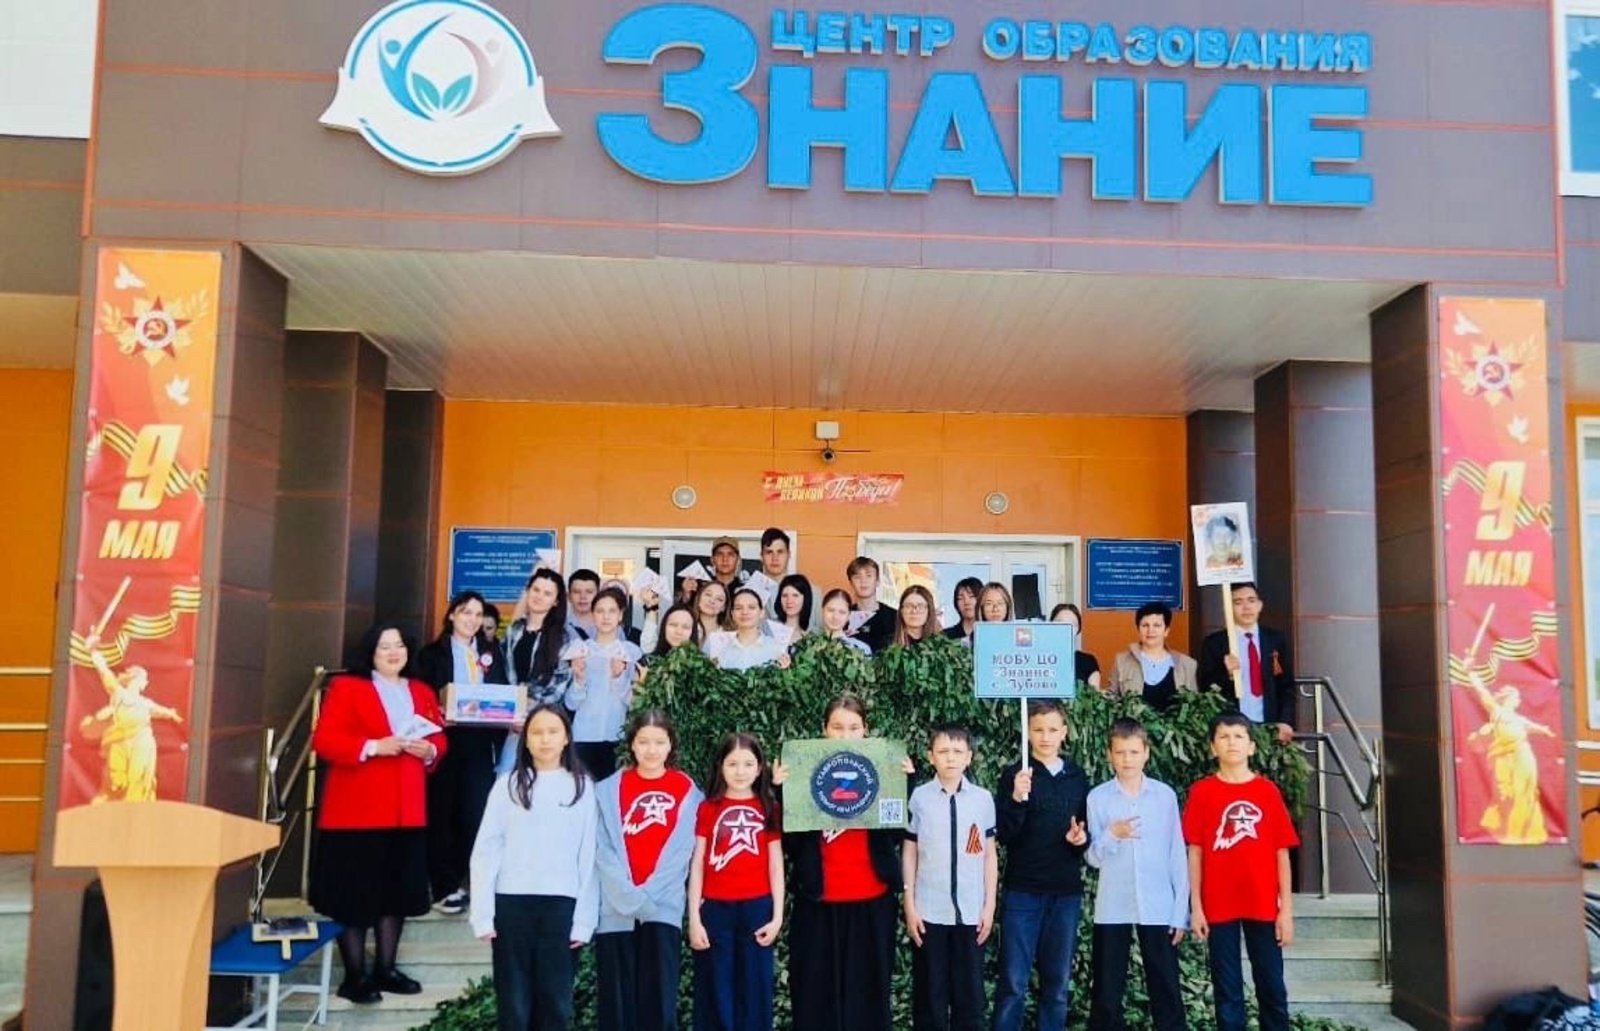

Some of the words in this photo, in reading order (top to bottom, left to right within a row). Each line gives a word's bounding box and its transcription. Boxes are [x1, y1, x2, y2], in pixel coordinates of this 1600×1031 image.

[771, 9, 955, 58] ЦЕНТР
[983, 18, 1370, 73] ОБРАЗОВАНИЯ
[596, 2, 1374, 208] ЗНАНИЕ
[117, 424, 184, 511] 9
[1474, 461, 1526, 541] 9
[98, 519, 181, 559] МАЯ
[1463, 550, 1535, 586] МАЯ
[992, 654, 1031, 665] МОБУ
[1037, 654, 1058, 665] ЦО
